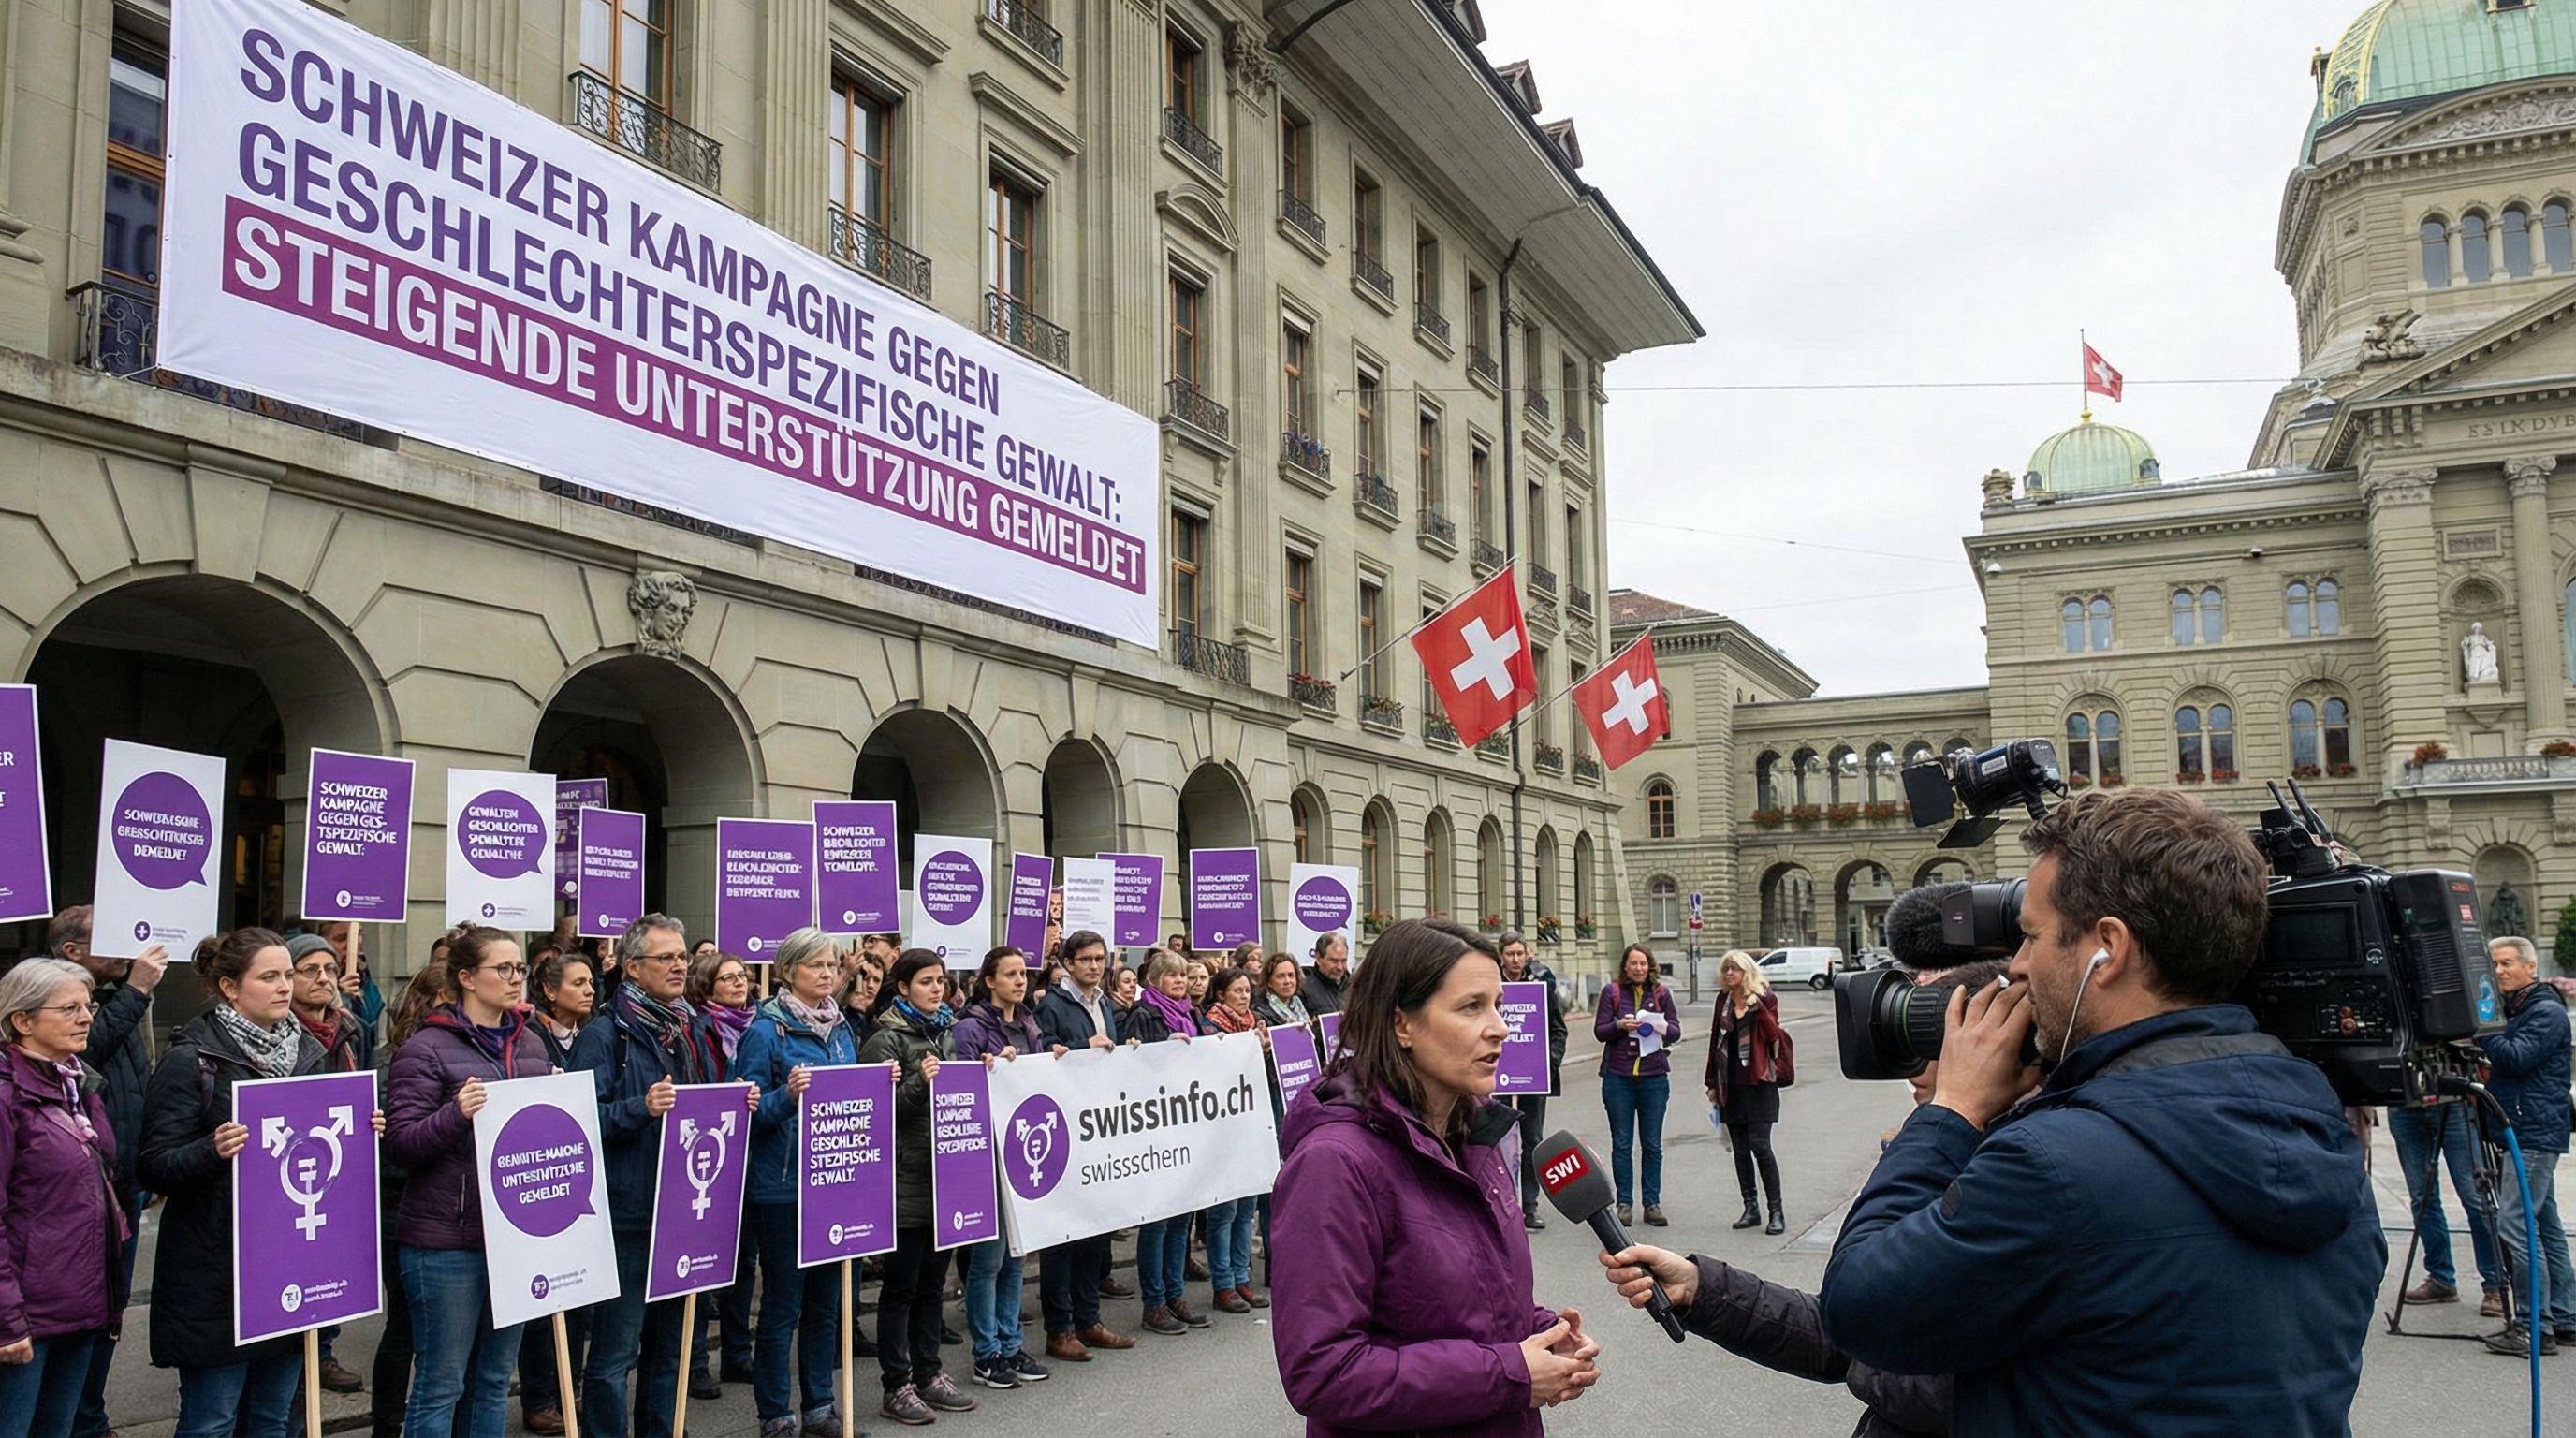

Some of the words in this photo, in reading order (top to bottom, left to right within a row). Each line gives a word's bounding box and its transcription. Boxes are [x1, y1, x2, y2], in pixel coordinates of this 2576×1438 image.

[241, 29, 609, 246] SCHWEIZER
[630, 203, 875, 362] KAMPAGNE
[888, 326, 999, 416] GEGEN
[240, 123, 985, 470] GESCHLECHTERSPEZIFISCHE
[996, 434, 1121, 523] GEWALT:
[234, 216, 596, 402] STEIGENDE
[615, 351, 978, 530] UNTERSTÜTZUNG
[989, 492, 1141, 585] GEMELDET
[318, 811, 359, 827] GEGEN
[320, 797, 385, 814] KAMPAGNE
[316, 841, 365, 856] GEWALT:
[1079, 1073, 1254, 1142] swissinfo.ch
[1081, 1144, 1191, 1186] swissschern
[1545, 1153, 1581, 1185] SWI
